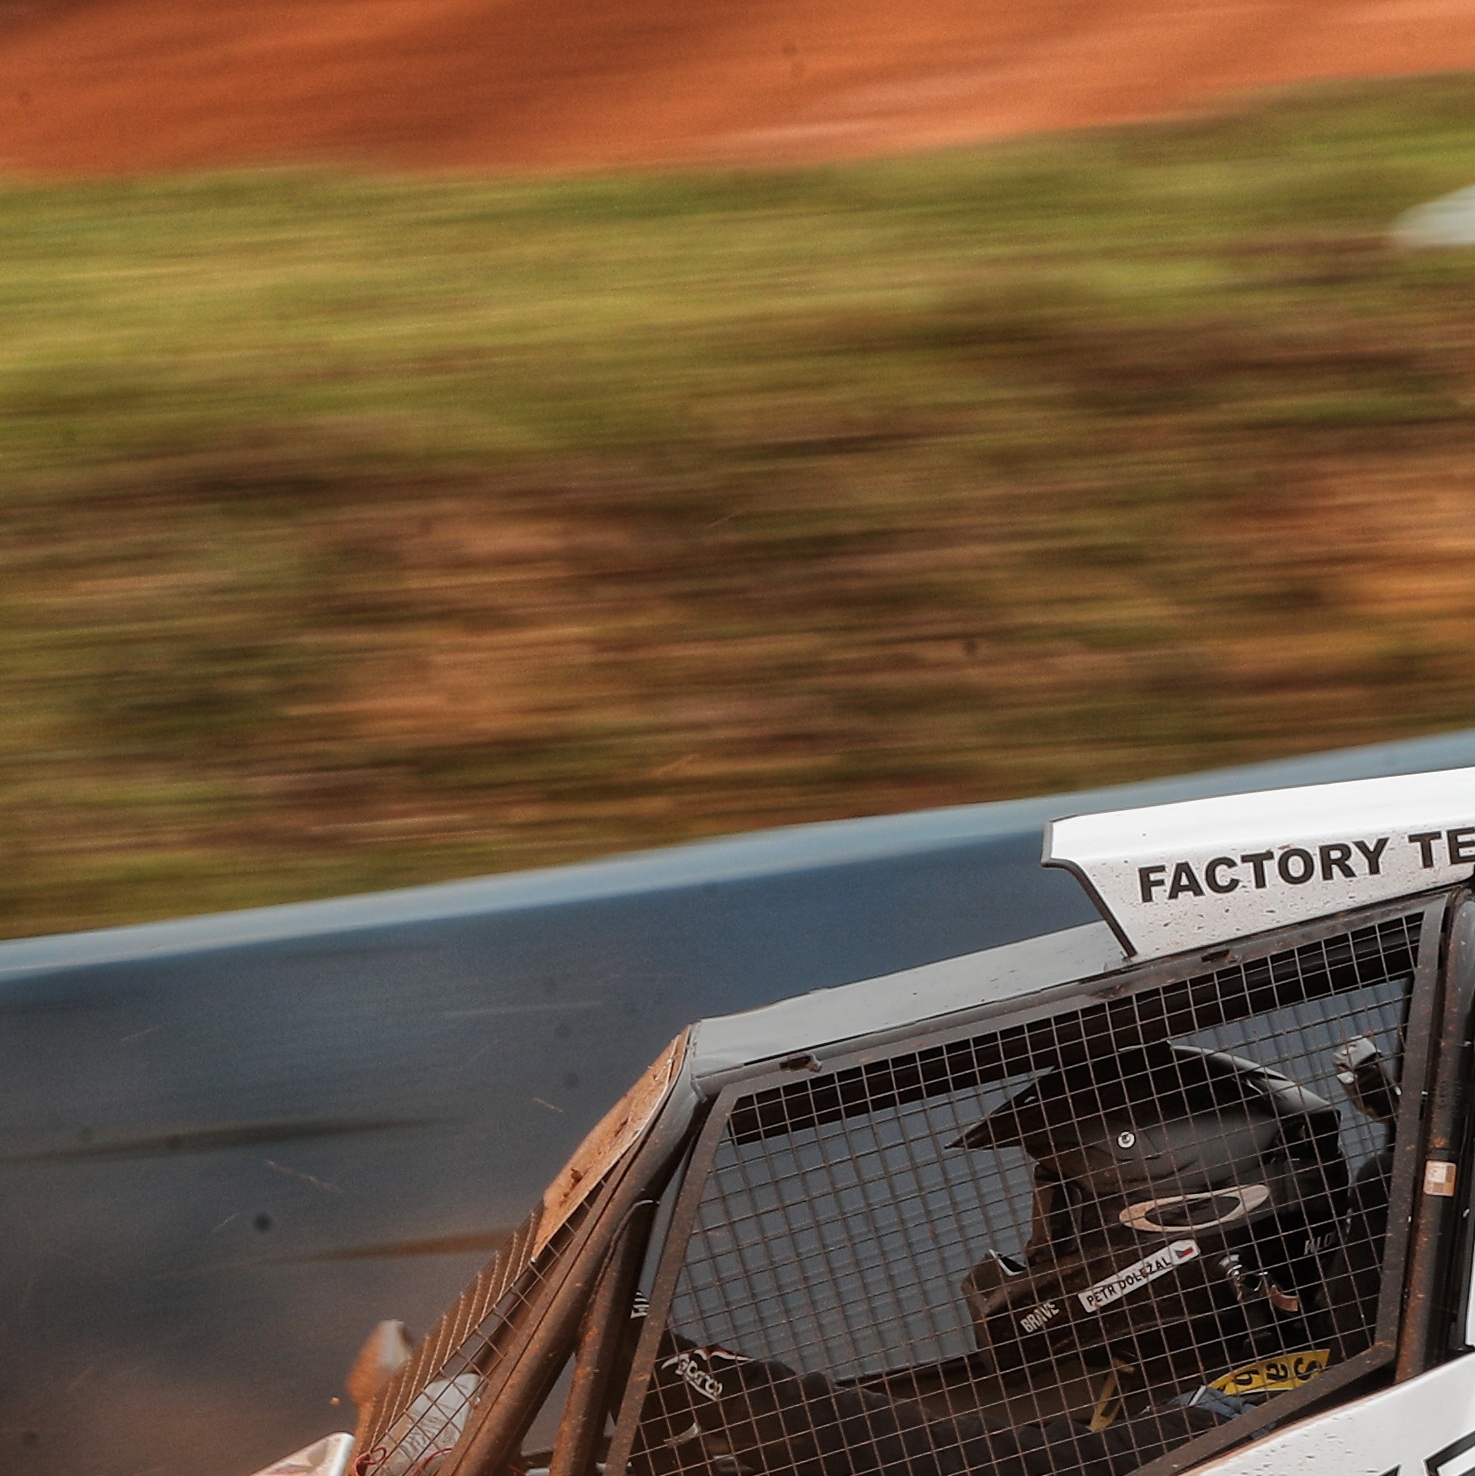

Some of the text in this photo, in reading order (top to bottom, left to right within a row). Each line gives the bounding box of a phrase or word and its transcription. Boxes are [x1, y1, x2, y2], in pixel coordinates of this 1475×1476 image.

[1137, 836, 1391, 903] FACTORY
[1086, 1284, 1117, 1307] PETR
[1020, 1301, 1060, 1334] BRAVE
